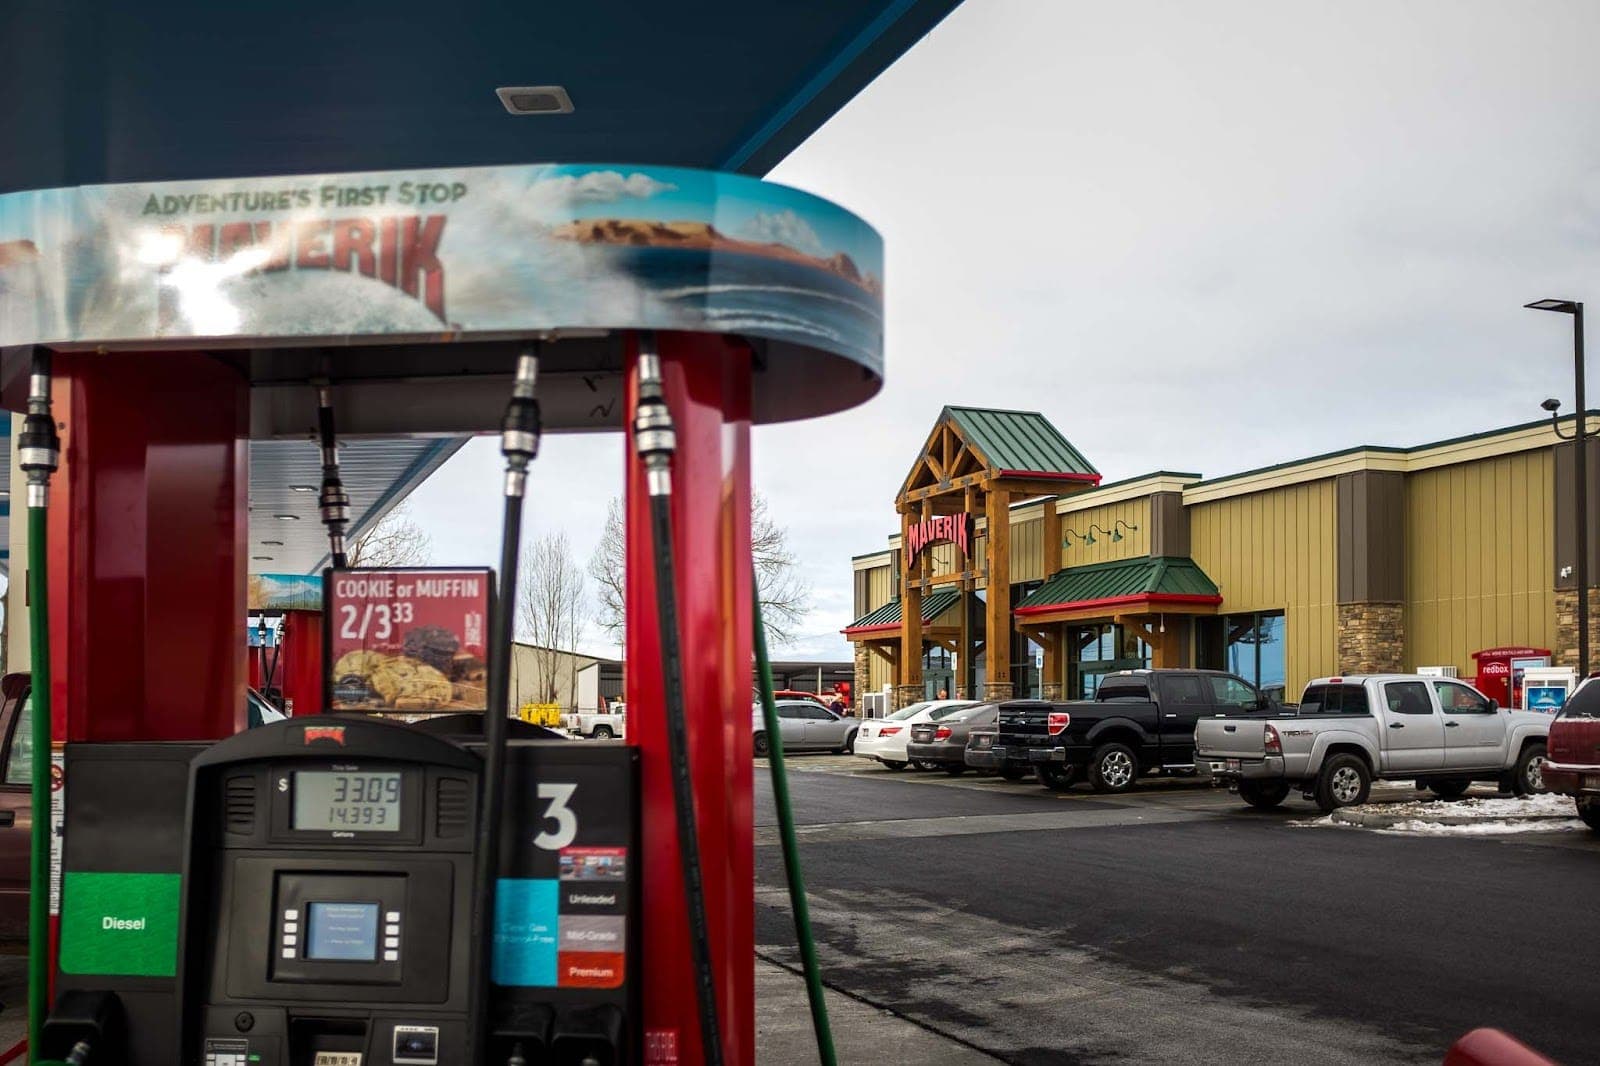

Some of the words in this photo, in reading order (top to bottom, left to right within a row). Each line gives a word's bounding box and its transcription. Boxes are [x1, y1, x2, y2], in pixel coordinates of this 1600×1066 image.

[319, 185, 390, 208] FIRST
[399, 181, 467, 204] STOP
[908, 511, 968, 568] MAVERIK
[336, 580, 394, 598] COOKIE
[396, 584, 414, 597] or
[415, 579, 479, 598] MUFFIN
[1482, 664, 1509, 674] redbox
[533, 783, 578, 850] 3
[102, 917, 145, 930] Diesel
[568, 967, 614, 977] Premium
